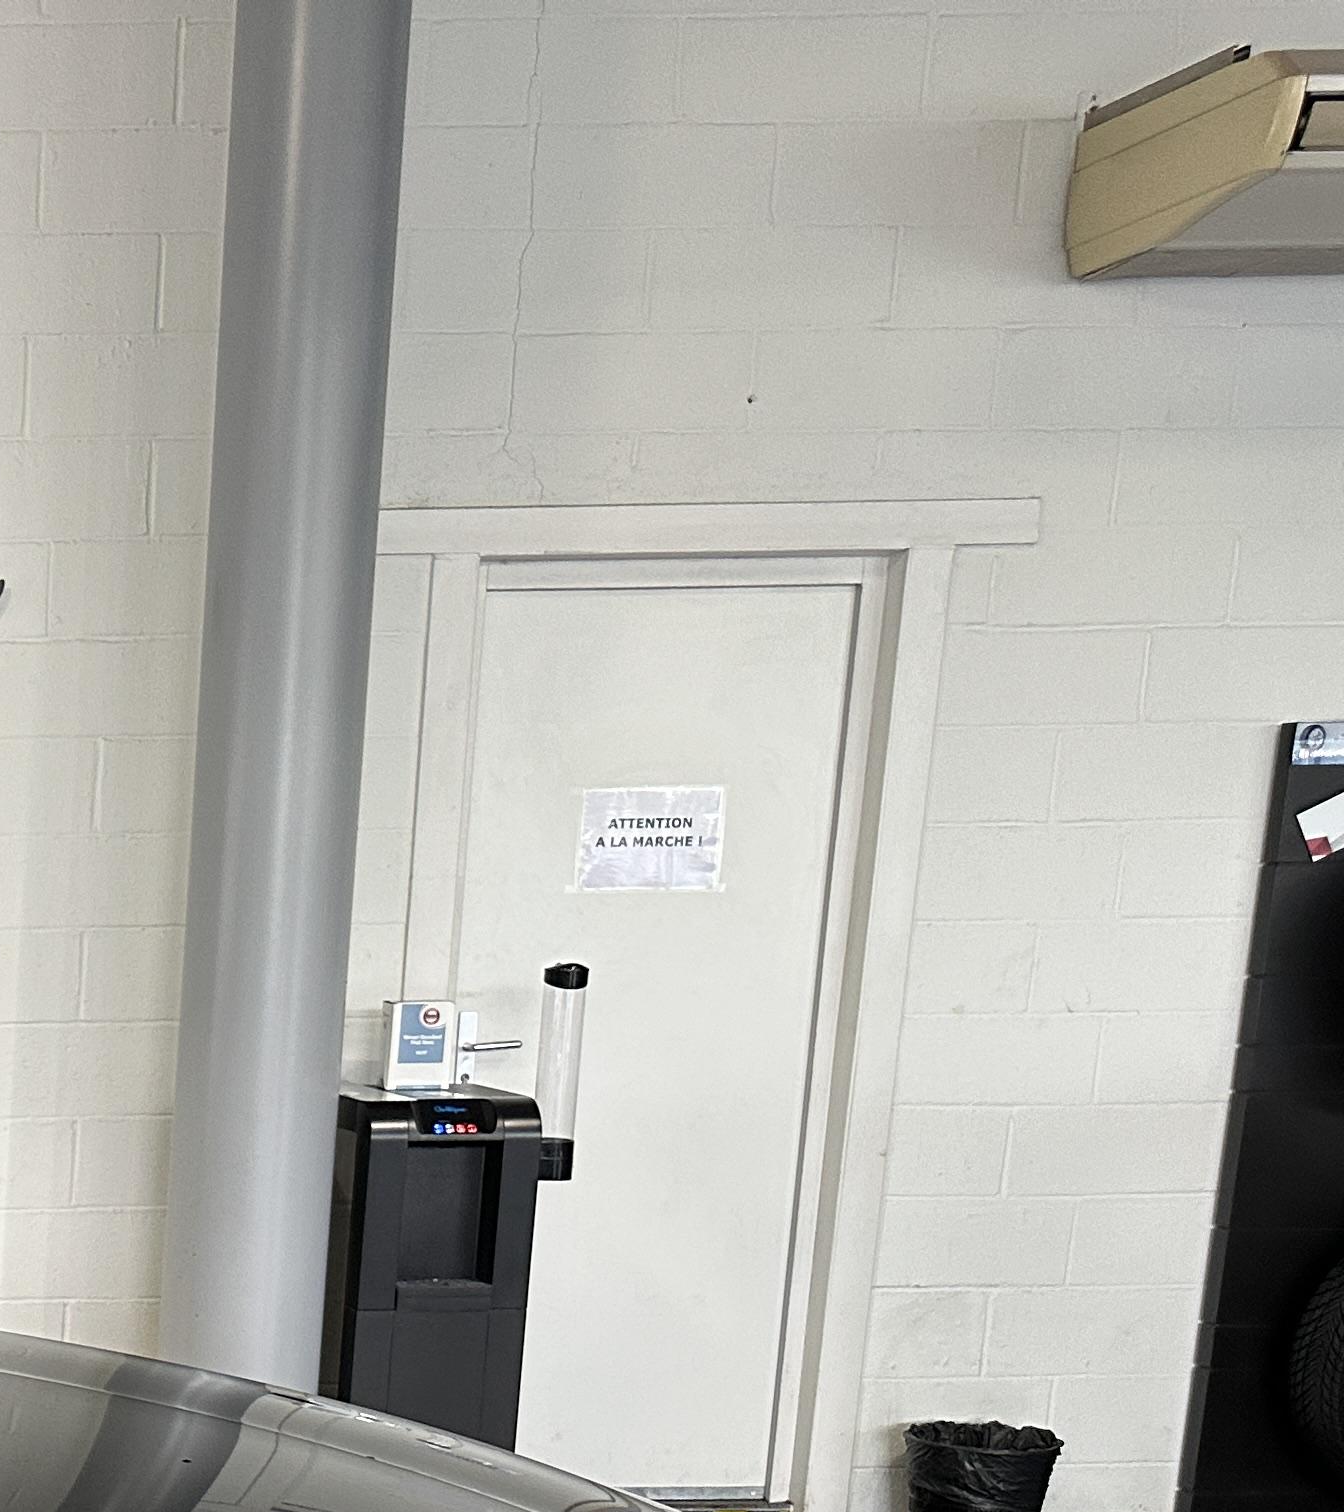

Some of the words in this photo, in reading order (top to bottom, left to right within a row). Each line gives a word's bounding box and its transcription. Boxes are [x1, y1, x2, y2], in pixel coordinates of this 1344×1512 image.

[608, 817, 693, 829] ATTENTION
[595, 836, 606, 848] A
[611, 836, 628, 848] LA
[632, 836, 693, 848] MARCHE
